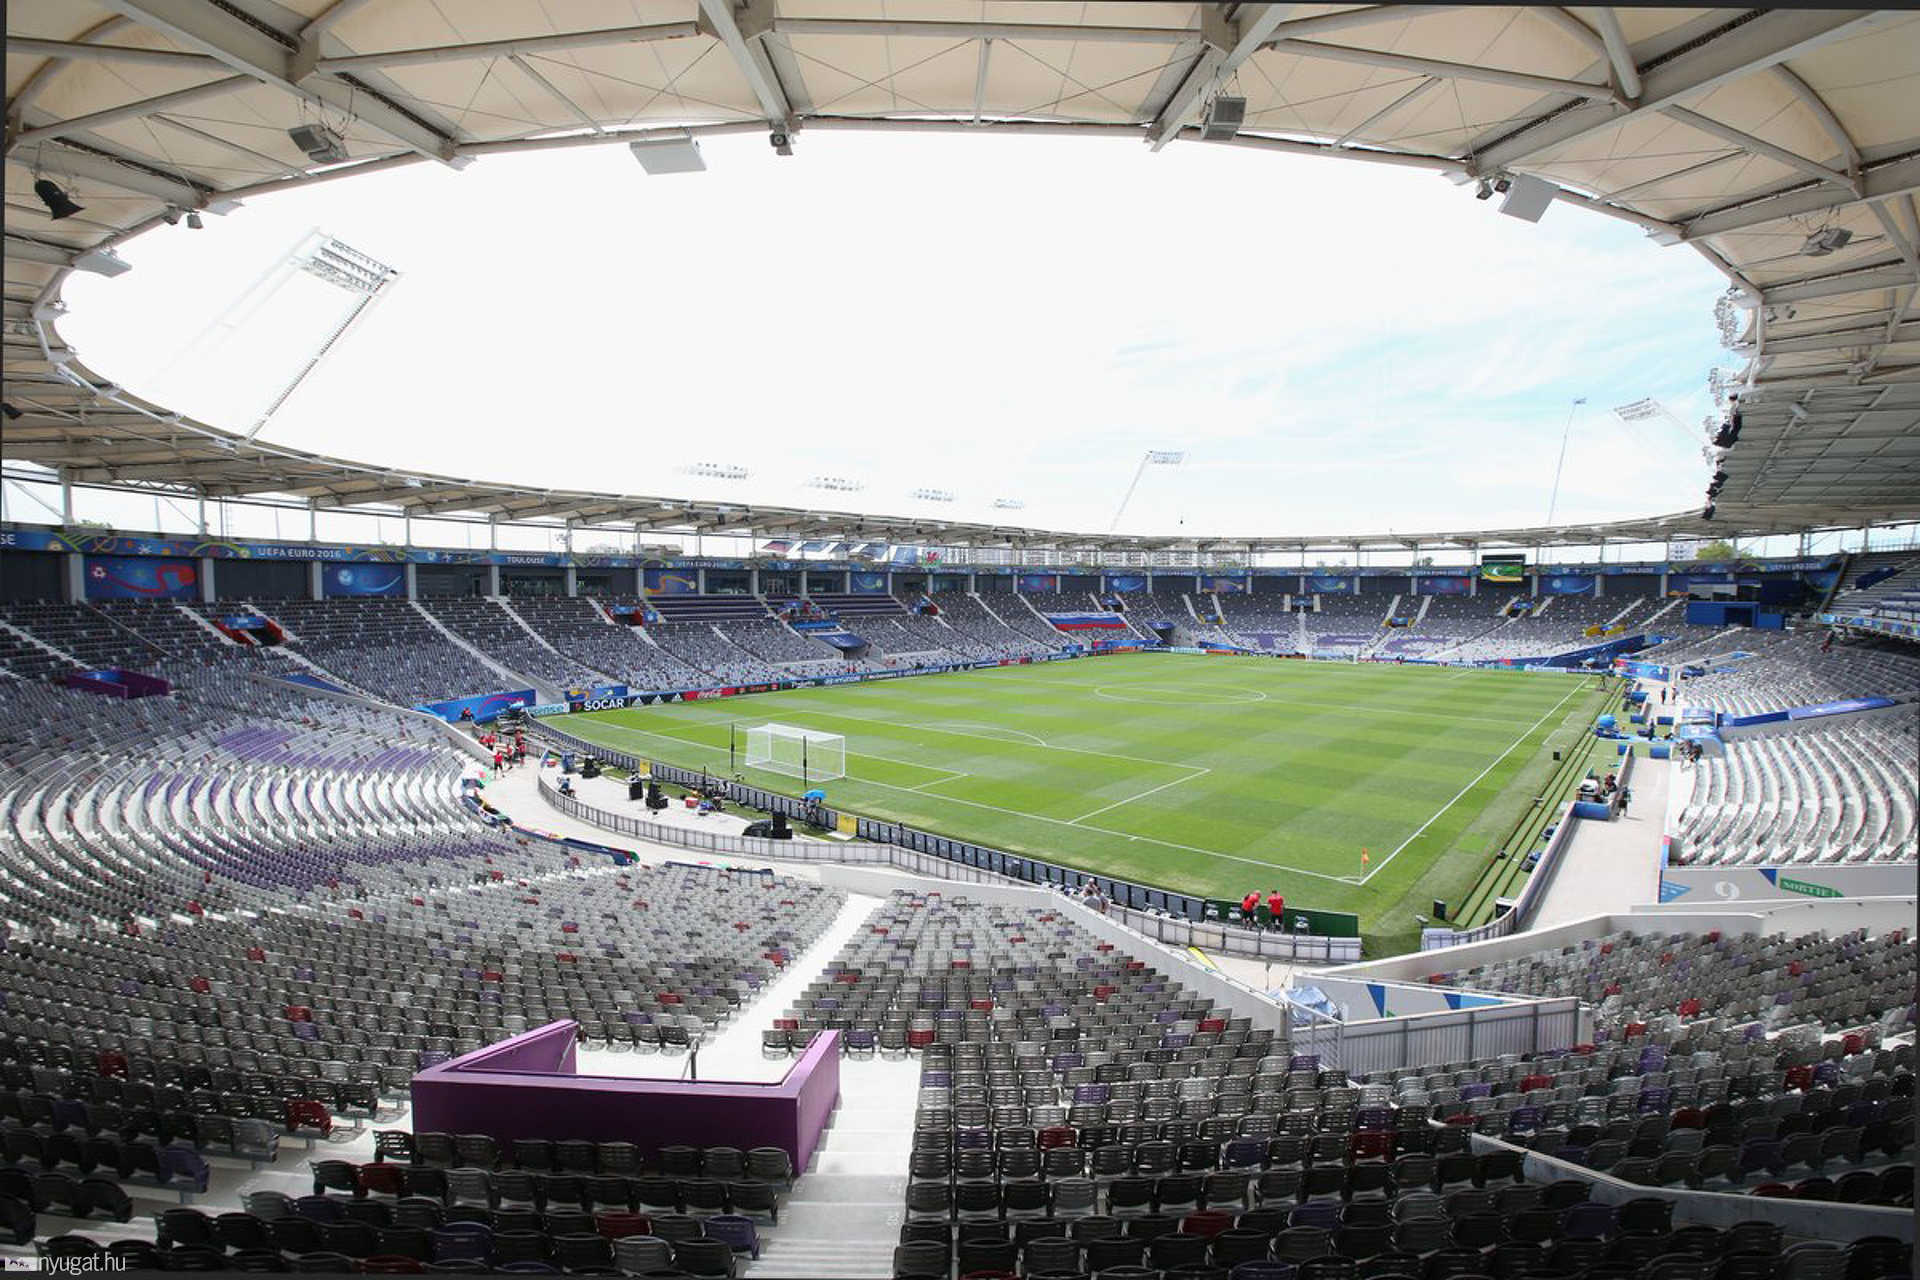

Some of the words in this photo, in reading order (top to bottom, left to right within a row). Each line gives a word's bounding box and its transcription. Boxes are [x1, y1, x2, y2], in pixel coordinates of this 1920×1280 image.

[257, 546, 286, 557] UEFA
[288, 548, 316, 558] EURO
[317, 549, 342, 559] 2016
[506, 556, 545, 564] TOULOUSE
[583, 698, 625, 712] SOCAR
[1714, 881, 1740, 900] 9
